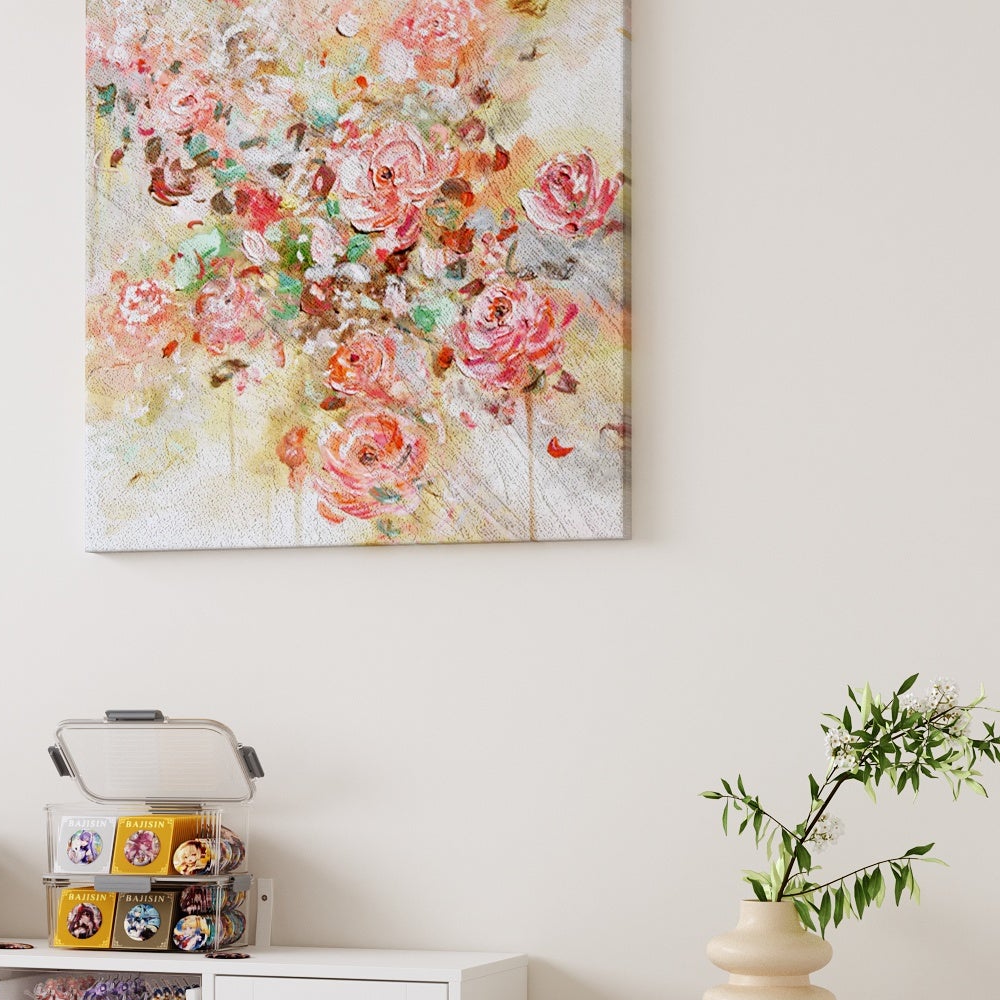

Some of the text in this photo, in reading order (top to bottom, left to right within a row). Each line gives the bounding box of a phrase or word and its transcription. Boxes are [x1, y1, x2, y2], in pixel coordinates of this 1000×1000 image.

[68, 820, 107, 828] BAJISIN
[125, 820, 165, 828] BAJISIN
[68, 893, 107, 901] BAJISIN
